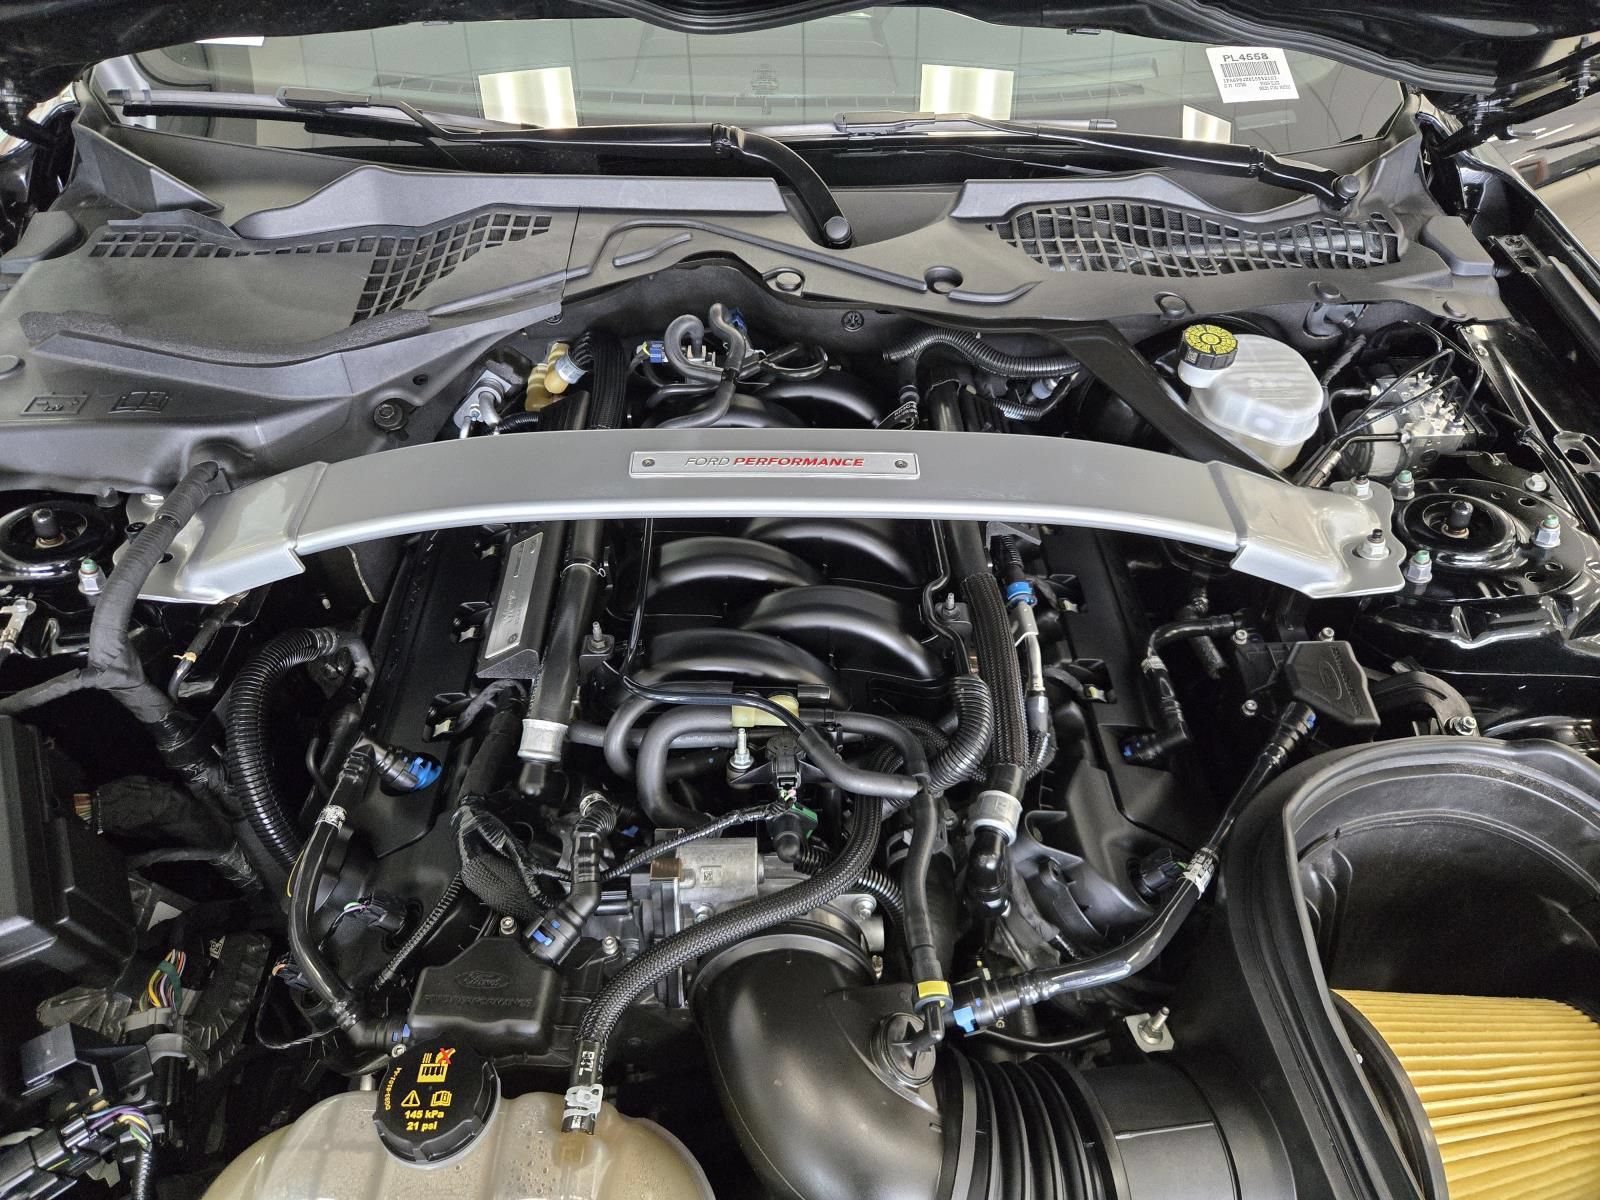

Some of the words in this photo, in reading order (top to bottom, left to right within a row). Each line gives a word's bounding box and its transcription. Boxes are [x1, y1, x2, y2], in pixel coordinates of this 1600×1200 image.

[684, 457, 730, 467] FORD
[733, 457, 865, 468] PERFORMANCE
[405, 1110, 423, 1119] 145
[425, 1110, 445, 1119] kPa
[406, 1121, 419, 1131] 21
[421, 1121, 438, 1132] psi
